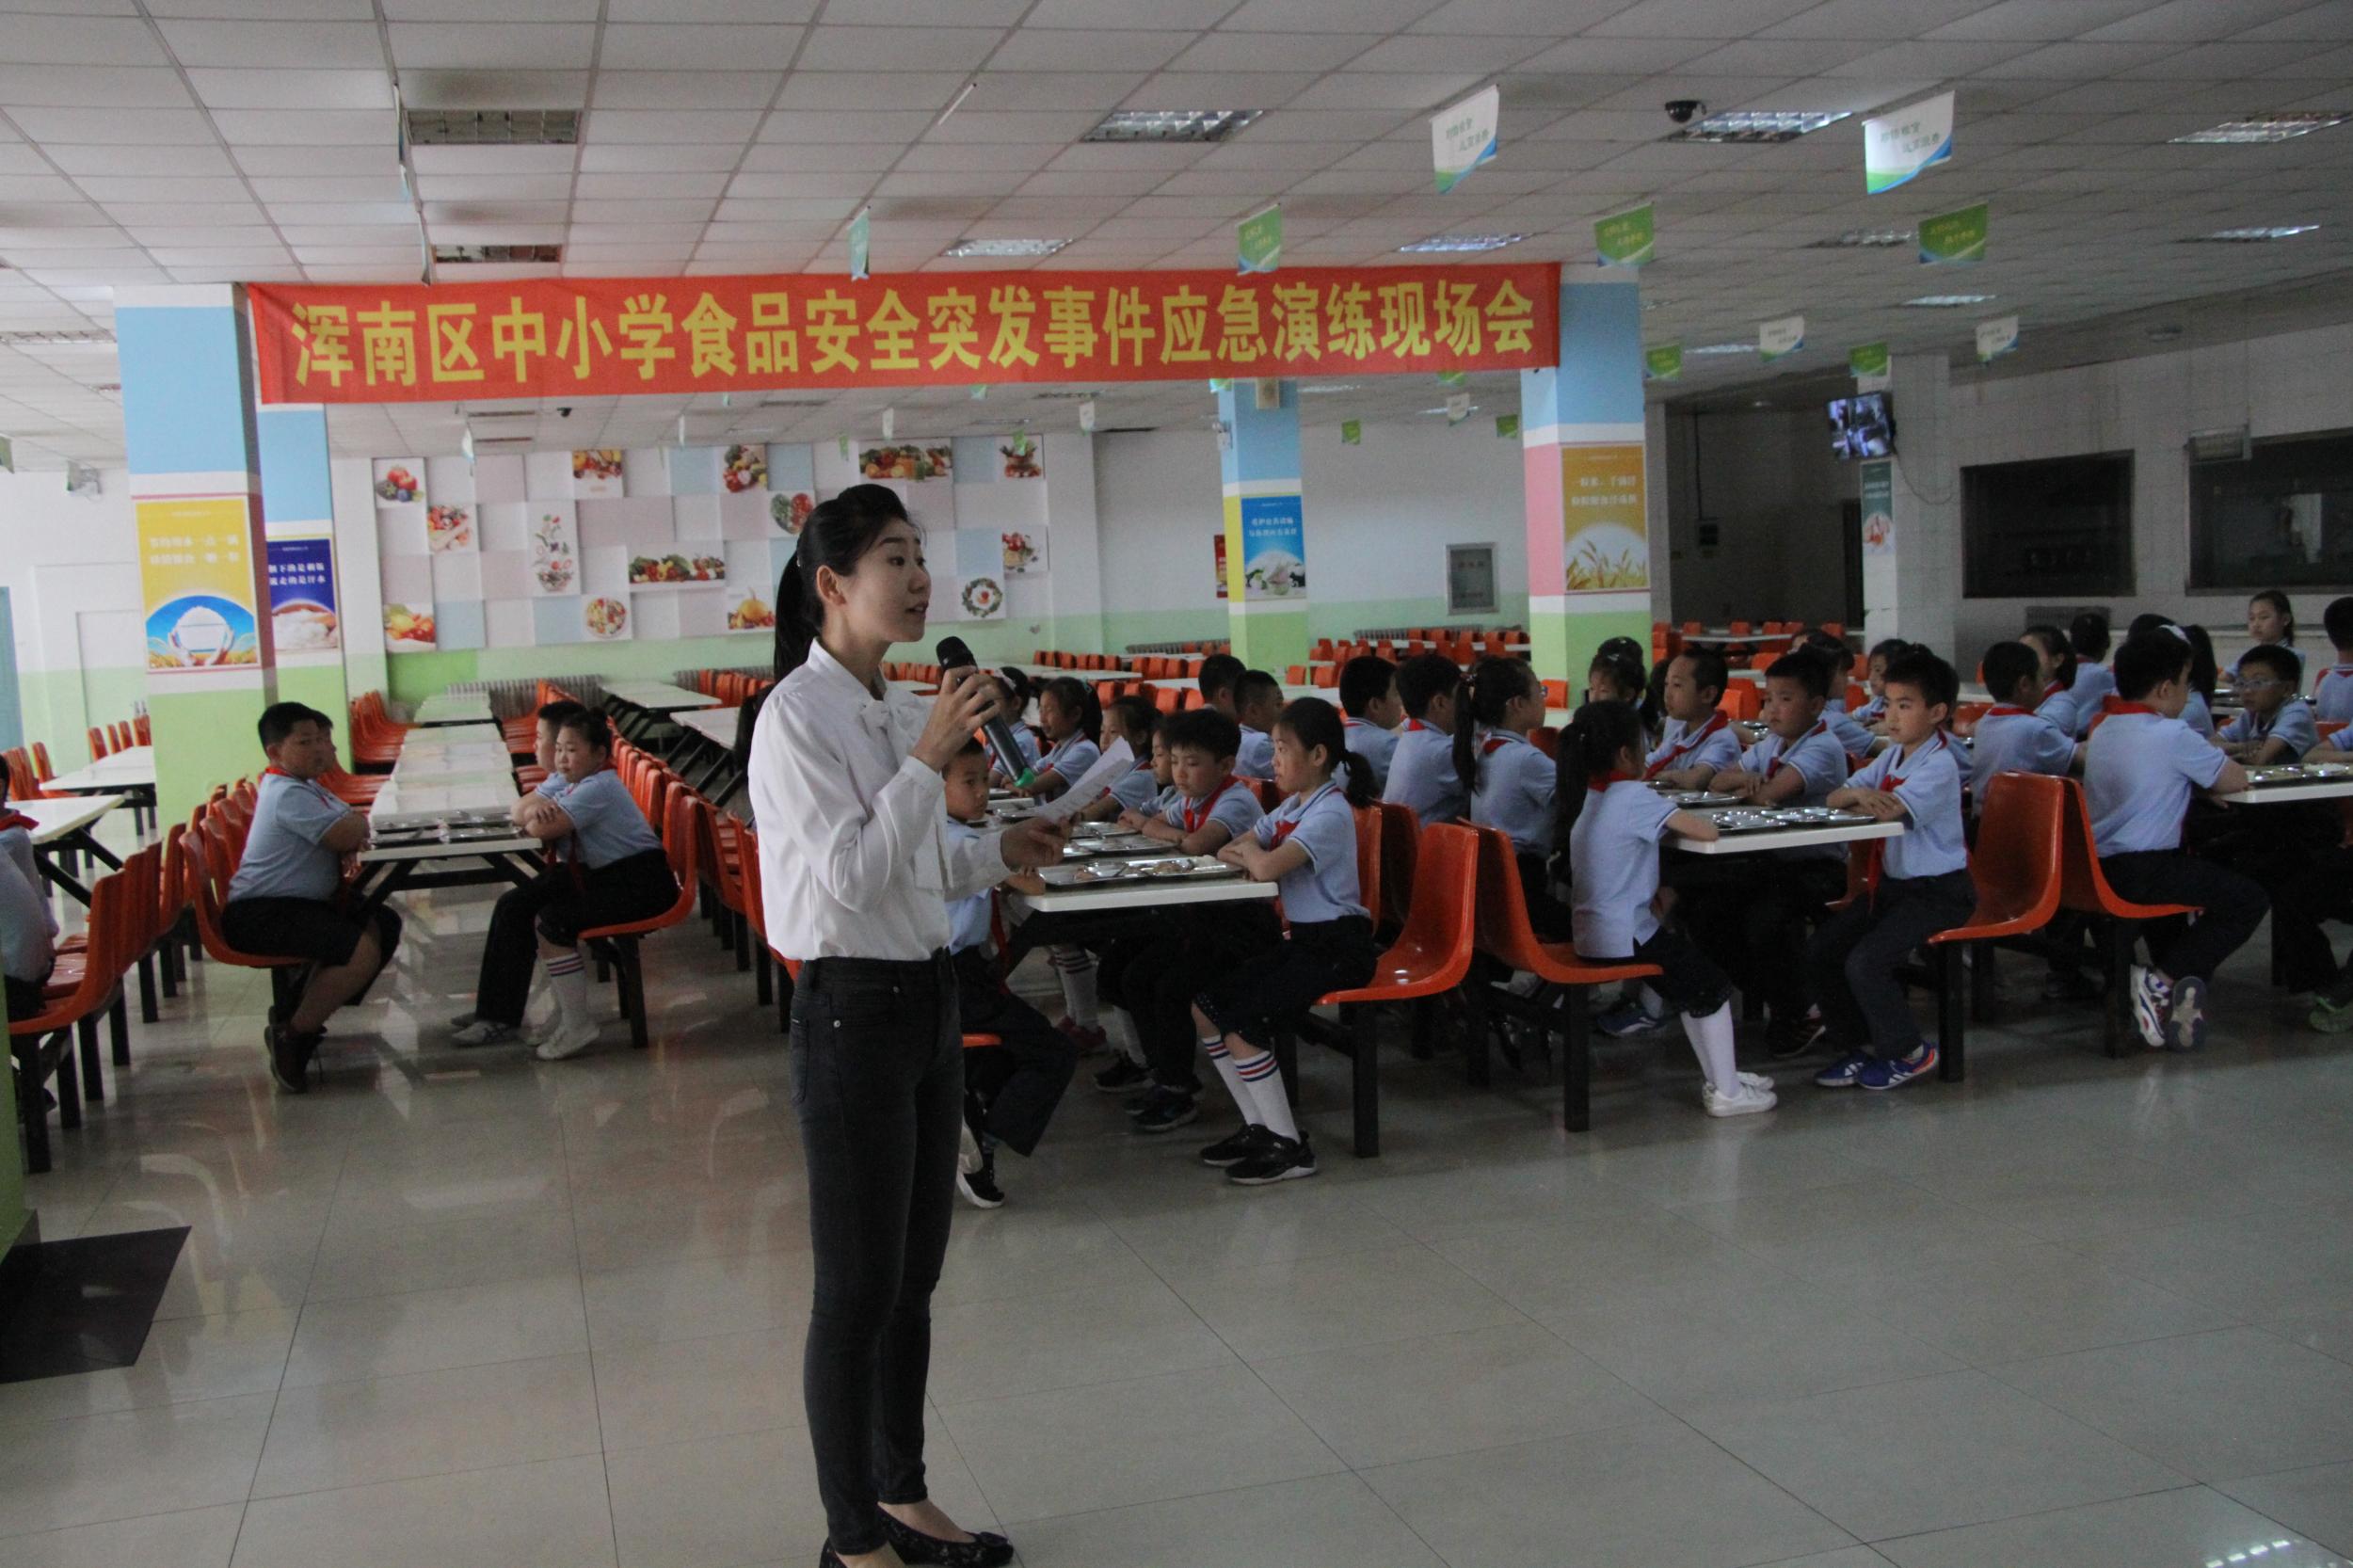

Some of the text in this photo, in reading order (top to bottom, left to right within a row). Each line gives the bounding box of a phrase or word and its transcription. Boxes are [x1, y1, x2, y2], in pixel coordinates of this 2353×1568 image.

[292, 280, 1533, 388] 浑南区中小学食品安全突发事件应急演练现场会
